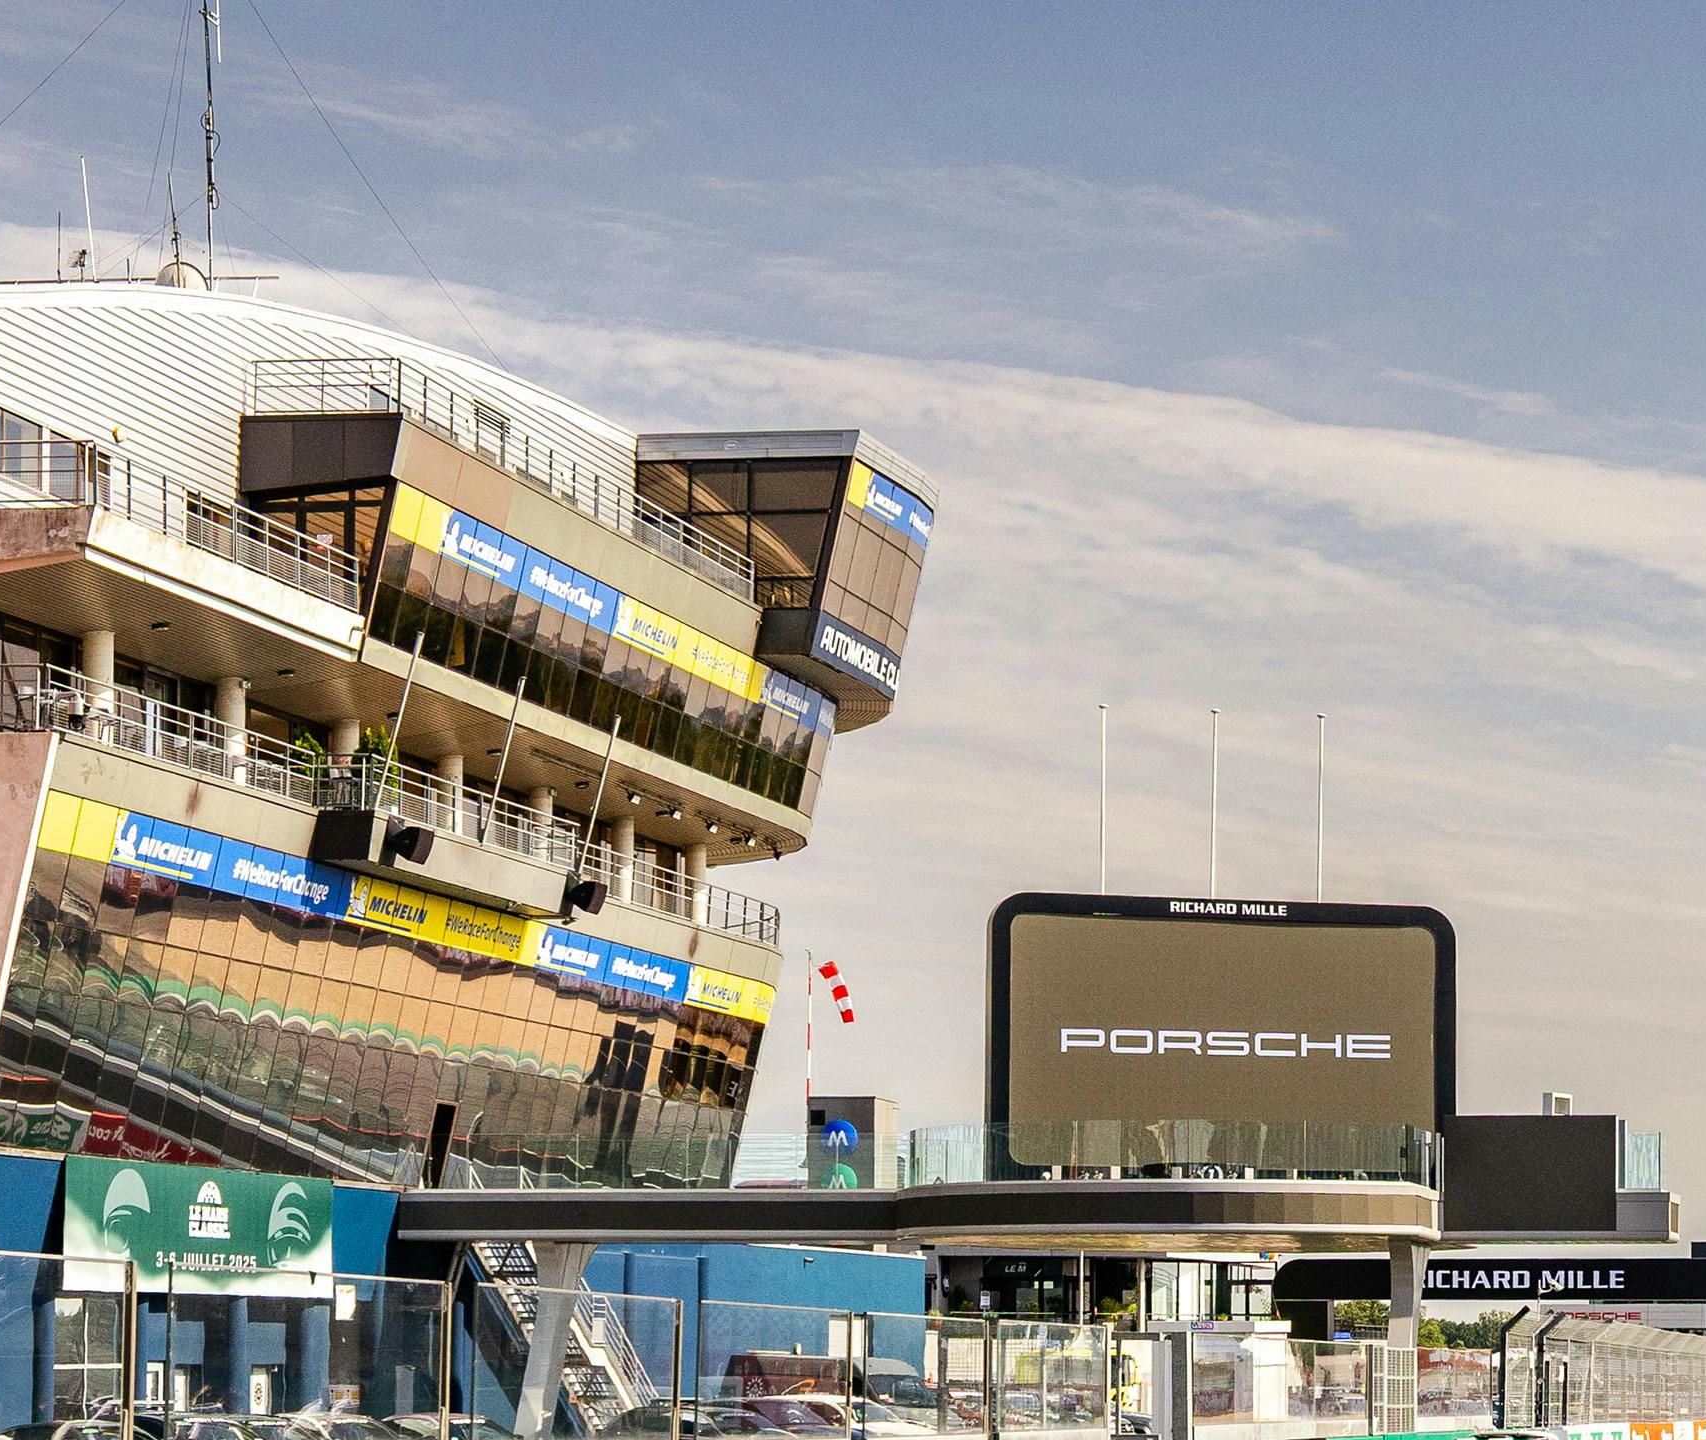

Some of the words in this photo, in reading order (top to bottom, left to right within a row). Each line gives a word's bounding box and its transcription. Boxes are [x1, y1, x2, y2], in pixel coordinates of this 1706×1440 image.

[459, 533, 516, 572] MICHELIN
[633, 619, 677, 649] MICHELIN
[820, 625, 887, 682] AUTOMOBILE
[773, 688, 810, 714] MICHELIN
[138, 837, 213, 871] MICHELIN
[233, 858, 329, 905] #WeRaceForChange
[1169, 900, 1236, 916] RICHARD
[1241, 902, 1287, 917] MILLE
[369, 896, 428, 924] MICHELIN
[446, 913, 521, 953] #WeRaceForChange
[553, 945, 600, 969] MICHELIN
[702, 983, 742, 1003] MICHELIN
[1060, 1028, 1391, 1059] PORSCHE
[189, 1205, 201, 1221] LE
[202, 1206, 229, 1222] MANS
[156, 1251, 176, 1270] 3-6
[181, 1252, 226, 1271] JUILLET
[228, 1255, 257, 1273] 2025
[1423, 1270, 1530, 1289] ICHARD
[1542, 1270, 1625, 1289] MILLE
